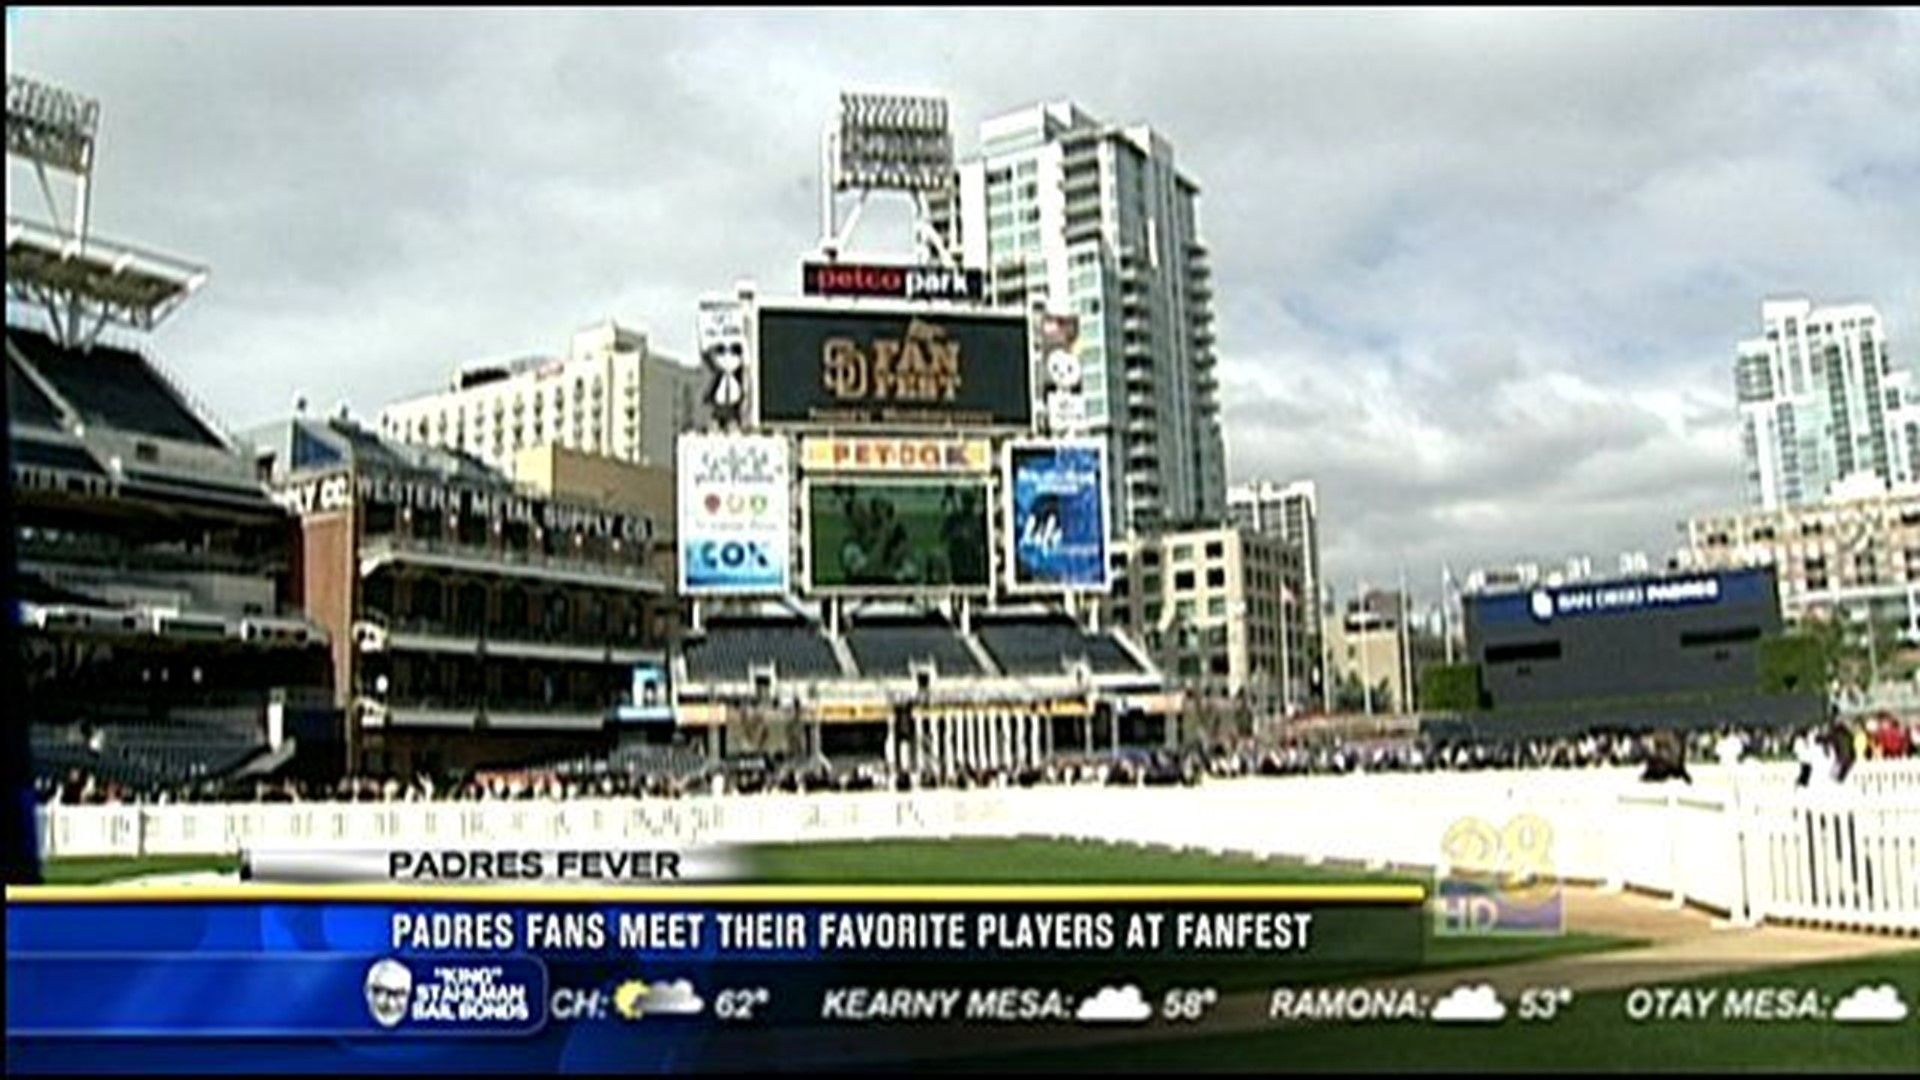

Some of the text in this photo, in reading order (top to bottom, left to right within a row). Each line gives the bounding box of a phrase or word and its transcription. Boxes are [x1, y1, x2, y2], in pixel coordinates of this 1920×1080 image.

[817, 267, 968, 298] petco park
[873, 339, 959, 373] FAN
